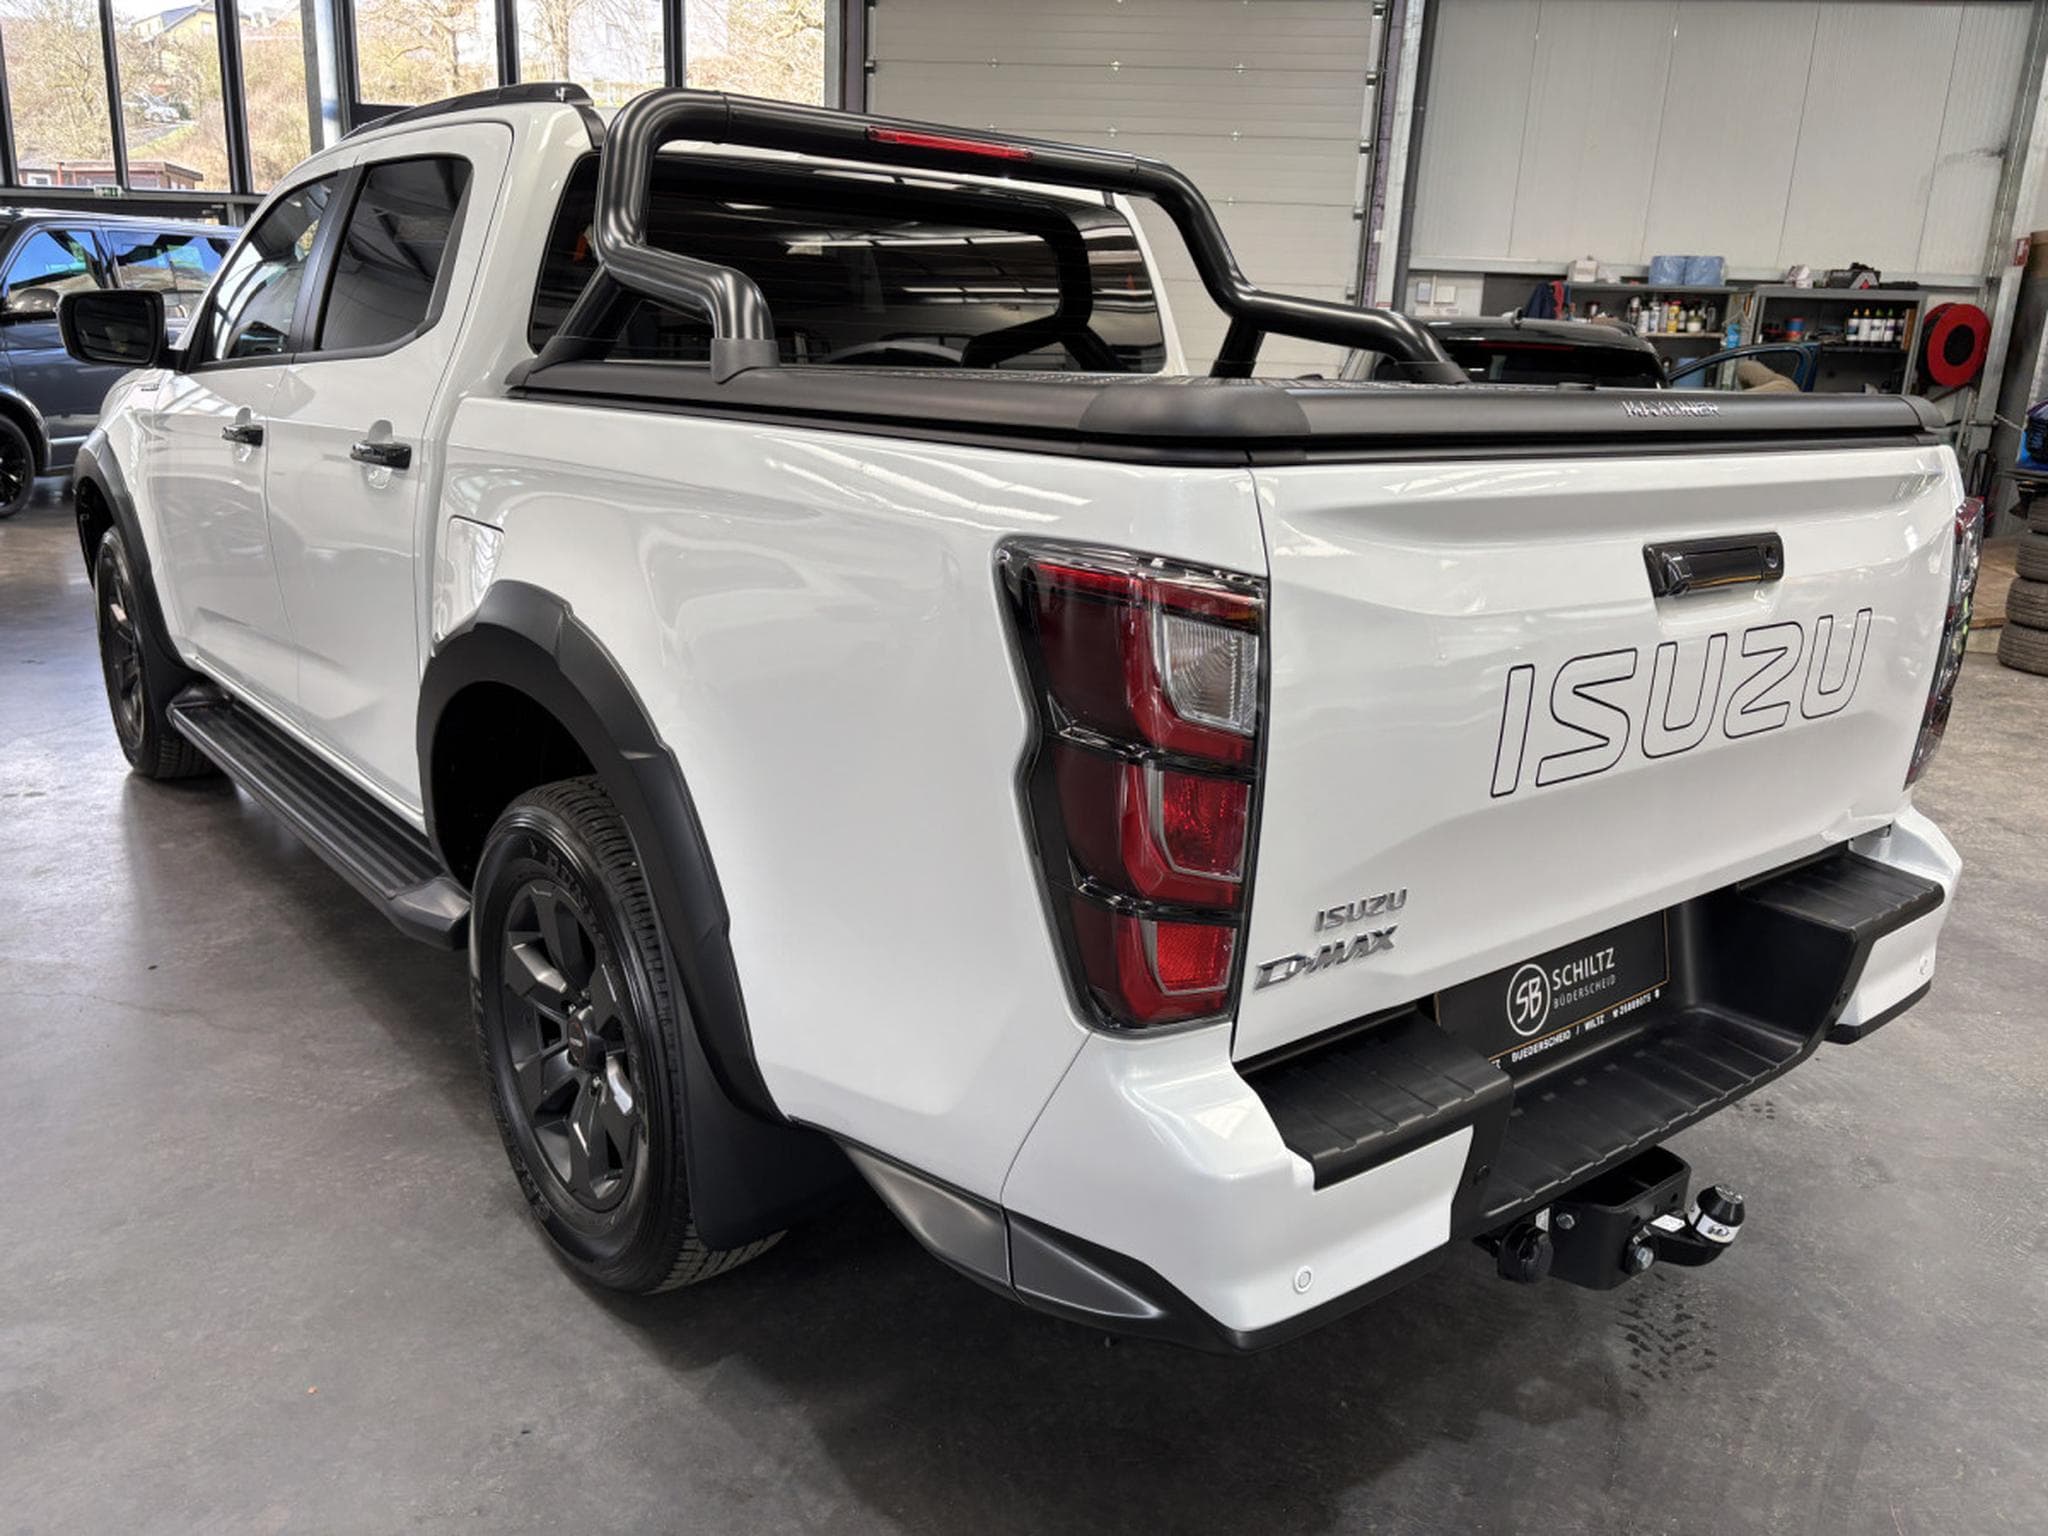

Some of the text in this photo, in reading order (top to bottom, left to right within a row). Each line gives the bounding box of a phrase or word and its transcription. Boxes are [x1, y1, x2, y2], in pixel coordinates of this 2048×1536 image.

[1490, 607, 1873, 798] ISUZU
[1314, 887, 1408, 932] ISUZU
[1254, 923, 1398, 990] D-MAX
[1552, 947, 1616, 991] SCHILTZ
[1553, 973, 1616, 1010] BÜDERSCHEID
[1584, 1013, 1605, 1031] WILTZ
